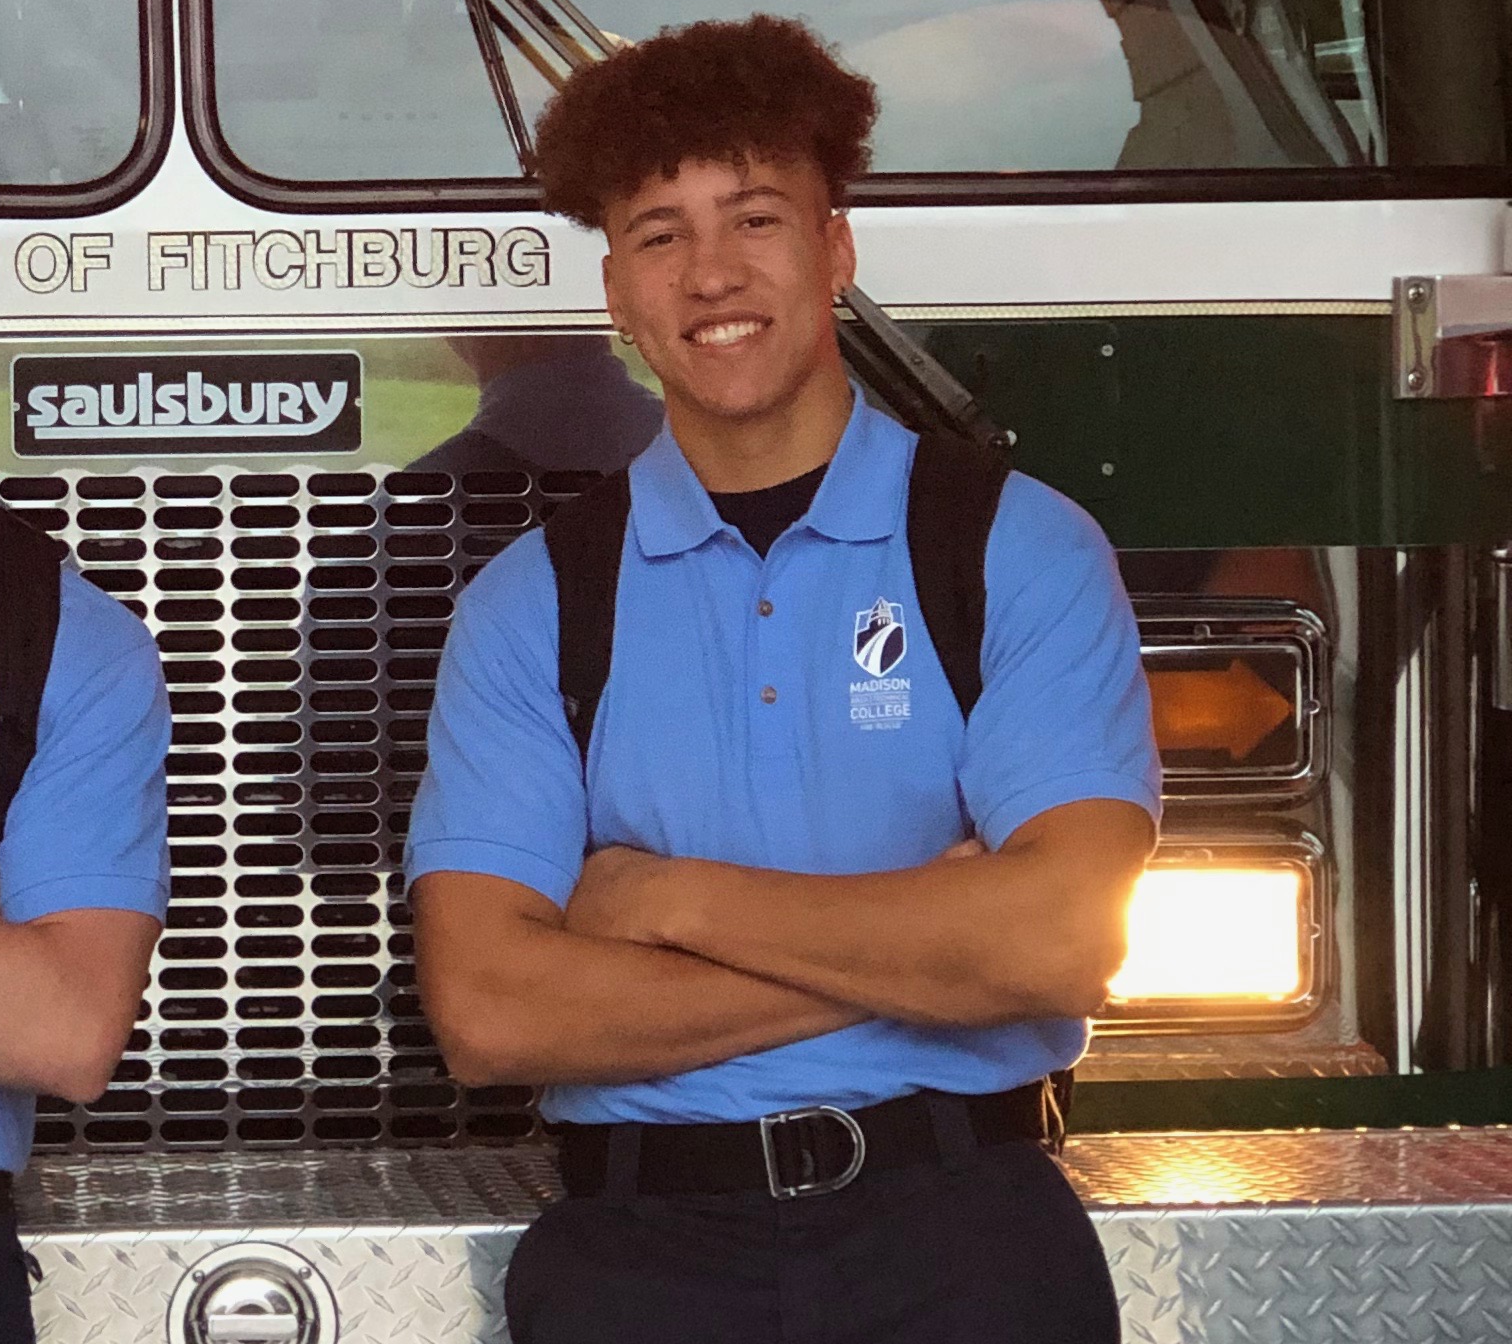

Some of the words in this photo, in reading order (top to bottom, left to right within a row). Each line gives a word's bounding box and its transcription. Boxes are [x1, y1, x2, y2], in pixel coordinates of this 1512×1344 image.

[14, 231, 113, 294] OF
[147, 227, 551, 292] FITCHBURG
[26, 372, 349, 439] saulsbury
[850, 678, 911, 693] MADISON
[850, 704, 911, 720] COLLEGE
